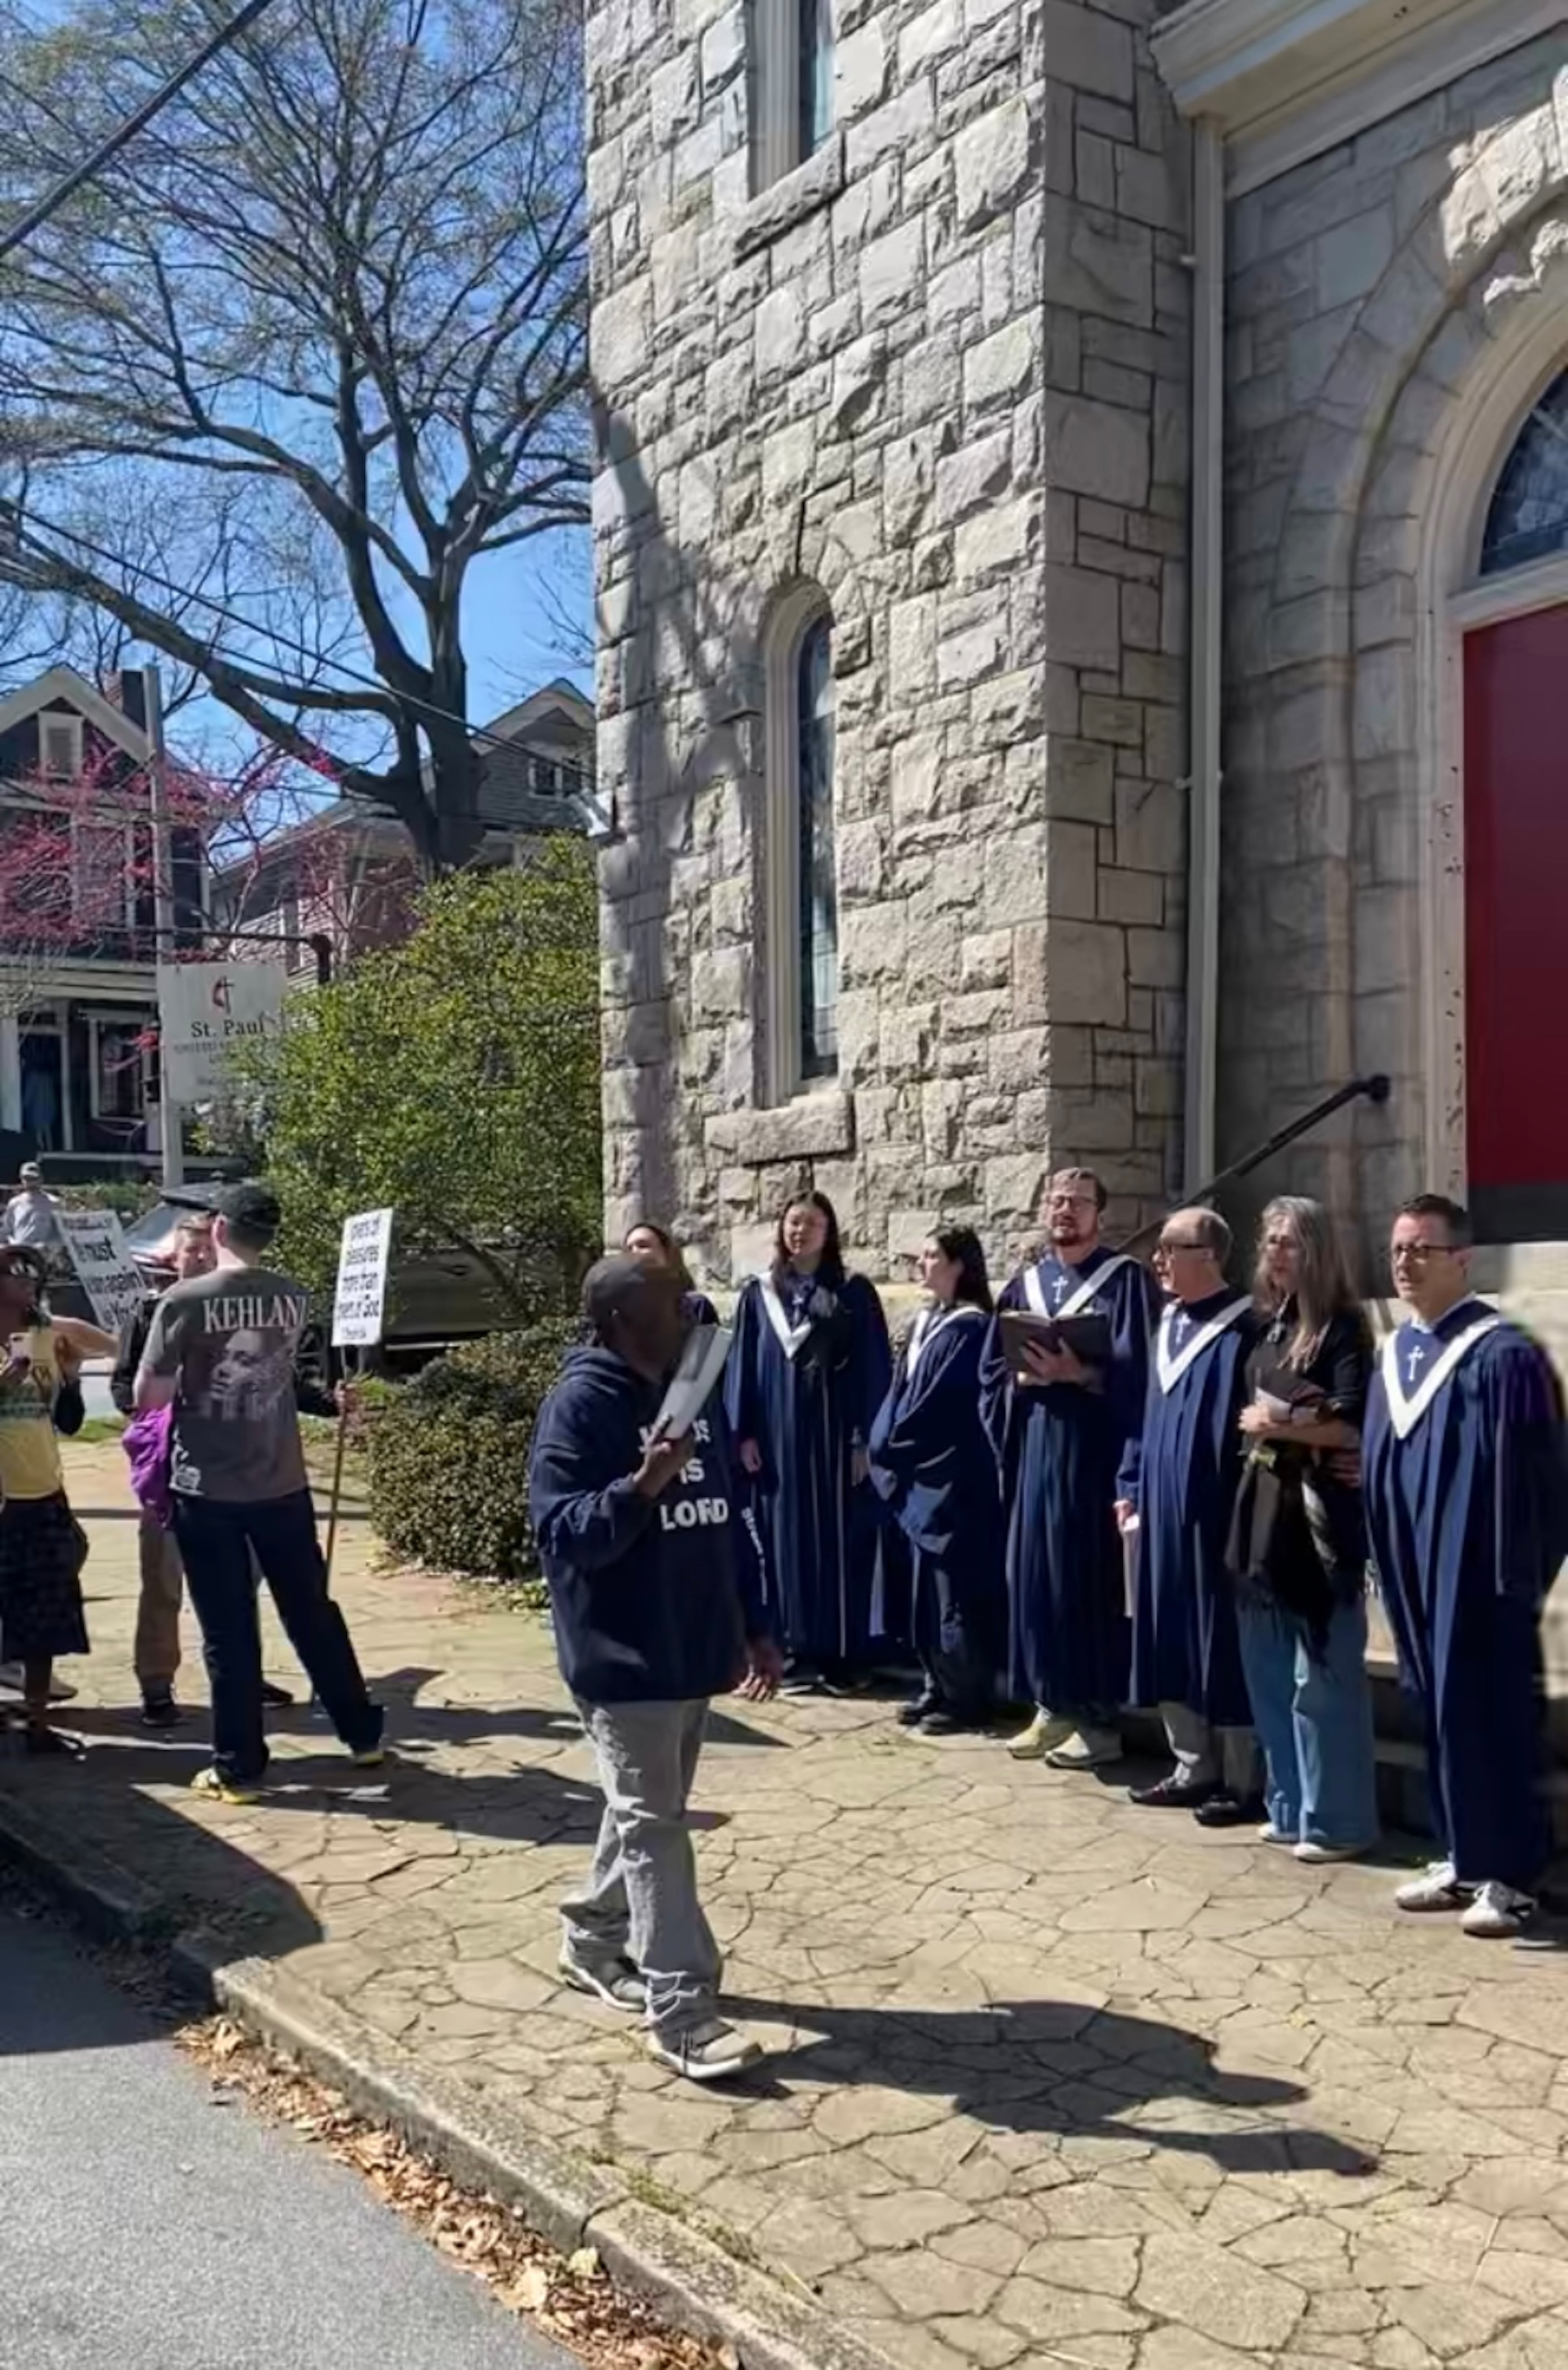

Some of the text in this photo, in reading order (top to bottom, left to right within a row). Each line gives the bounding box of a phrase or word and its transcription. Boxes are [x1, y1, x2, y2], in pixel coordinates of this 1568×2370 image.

[191, 1014, 265, 1038] St. Paul
[679, 1457, 706, 1485] IS
[659, 1497, 728, 1530] LORD
